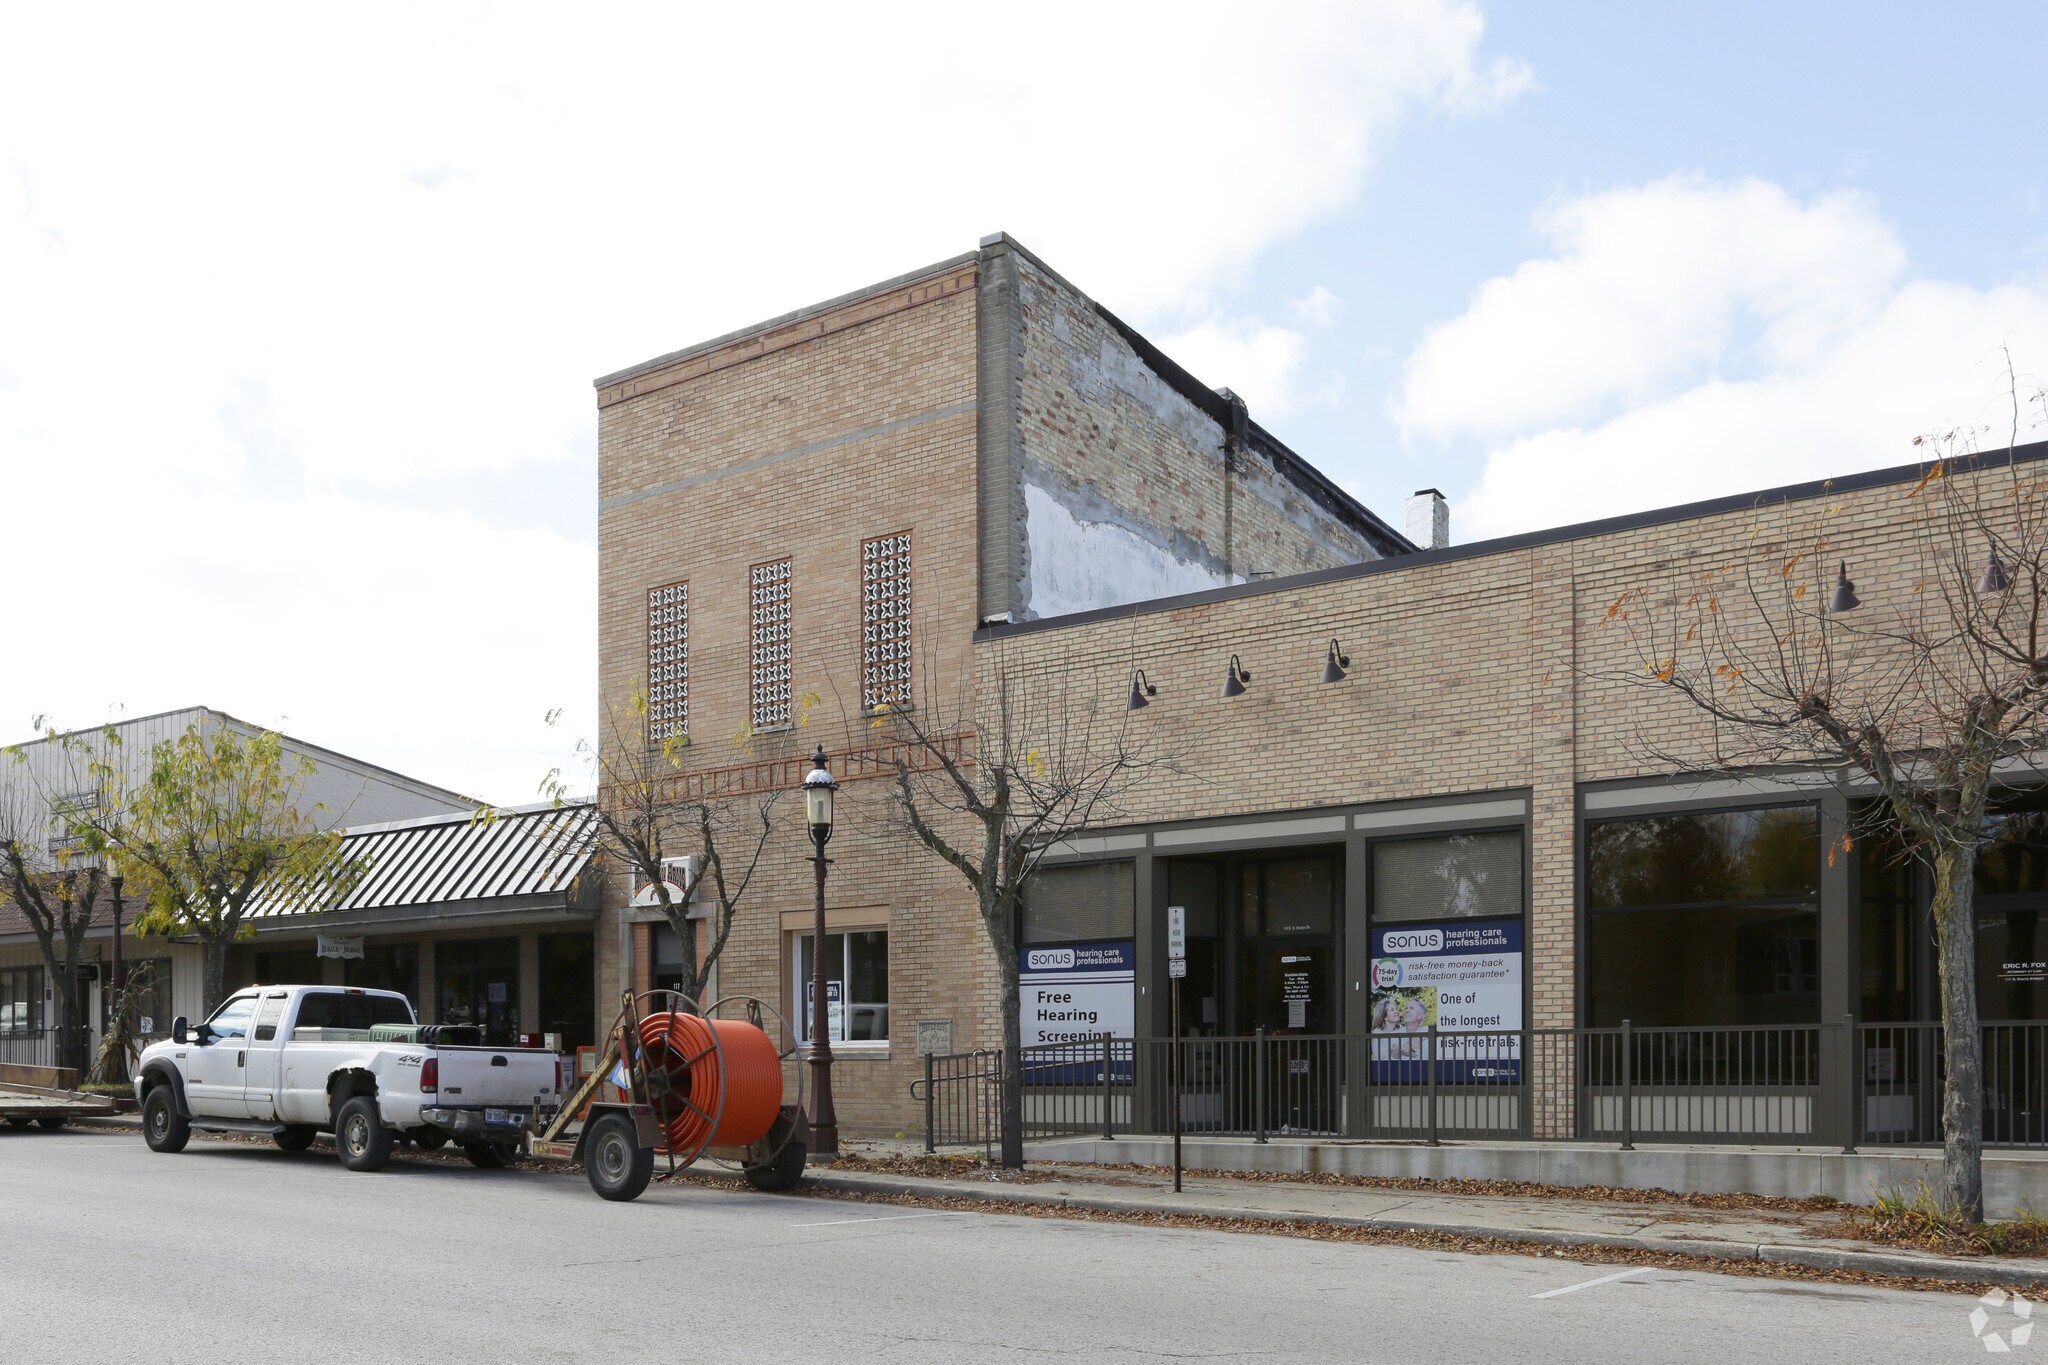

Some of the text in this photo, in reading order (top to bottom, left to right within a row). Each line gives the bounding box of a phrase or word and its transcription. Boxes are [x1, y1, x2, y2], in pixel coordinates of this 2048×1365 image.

[1446, 928, 1502, 939] hearing care
[1387, 934, 1438, 948] sonus
[1446, 936, 1507, 949] professionals
[1031, 953, 1071, 965] sonus
[1076, 949, 1102, 957] hearing
[1076, 956, 1123, 966] professionals
[1408, 959, 1504, 970] risk-free money-back
[1378, 968, 1397, 976] 75-day
[1408, 970, 1457, 981] satisfaction
[1037, 990, 1072, 1004] Free
[1440, 992, 1476, 1004] One of
[1037, 1008, 1098, 1024] Hearing
[1440, 1014, 1501, 1028] the longest
[1440, 1036, 1485, 1048] risk-ree
[1487, 1036, 1519, 1048] trals.
